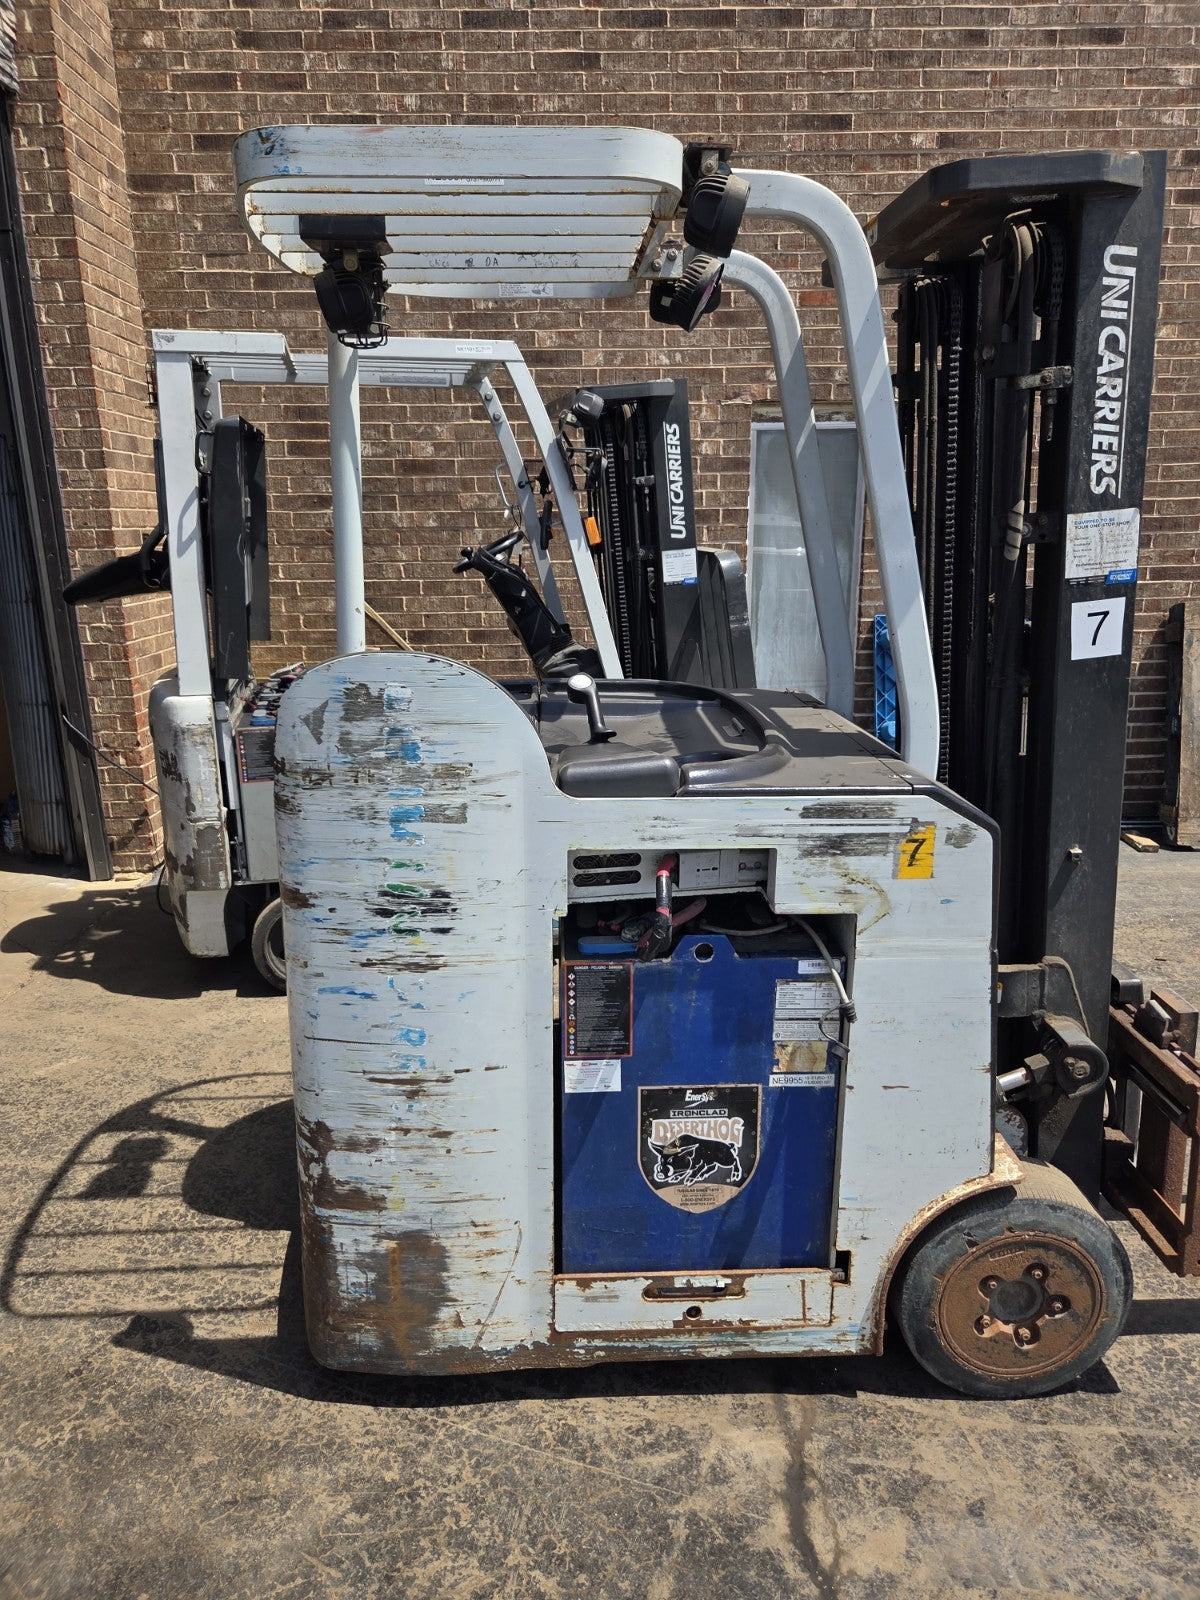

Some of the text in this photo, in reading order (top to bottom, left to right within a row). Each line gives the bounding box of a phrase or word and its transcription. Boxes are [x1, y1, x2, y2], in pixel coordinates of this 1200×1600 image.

[1087, 610, 1110, 646] 7
[905, 838, 927, 867] 7
[772, 1076, 804, 1085] NE9955
[671, 1109, 728, 1117] IRONCLAD
[653, 1119, 742, 1146] DESERTHOG
